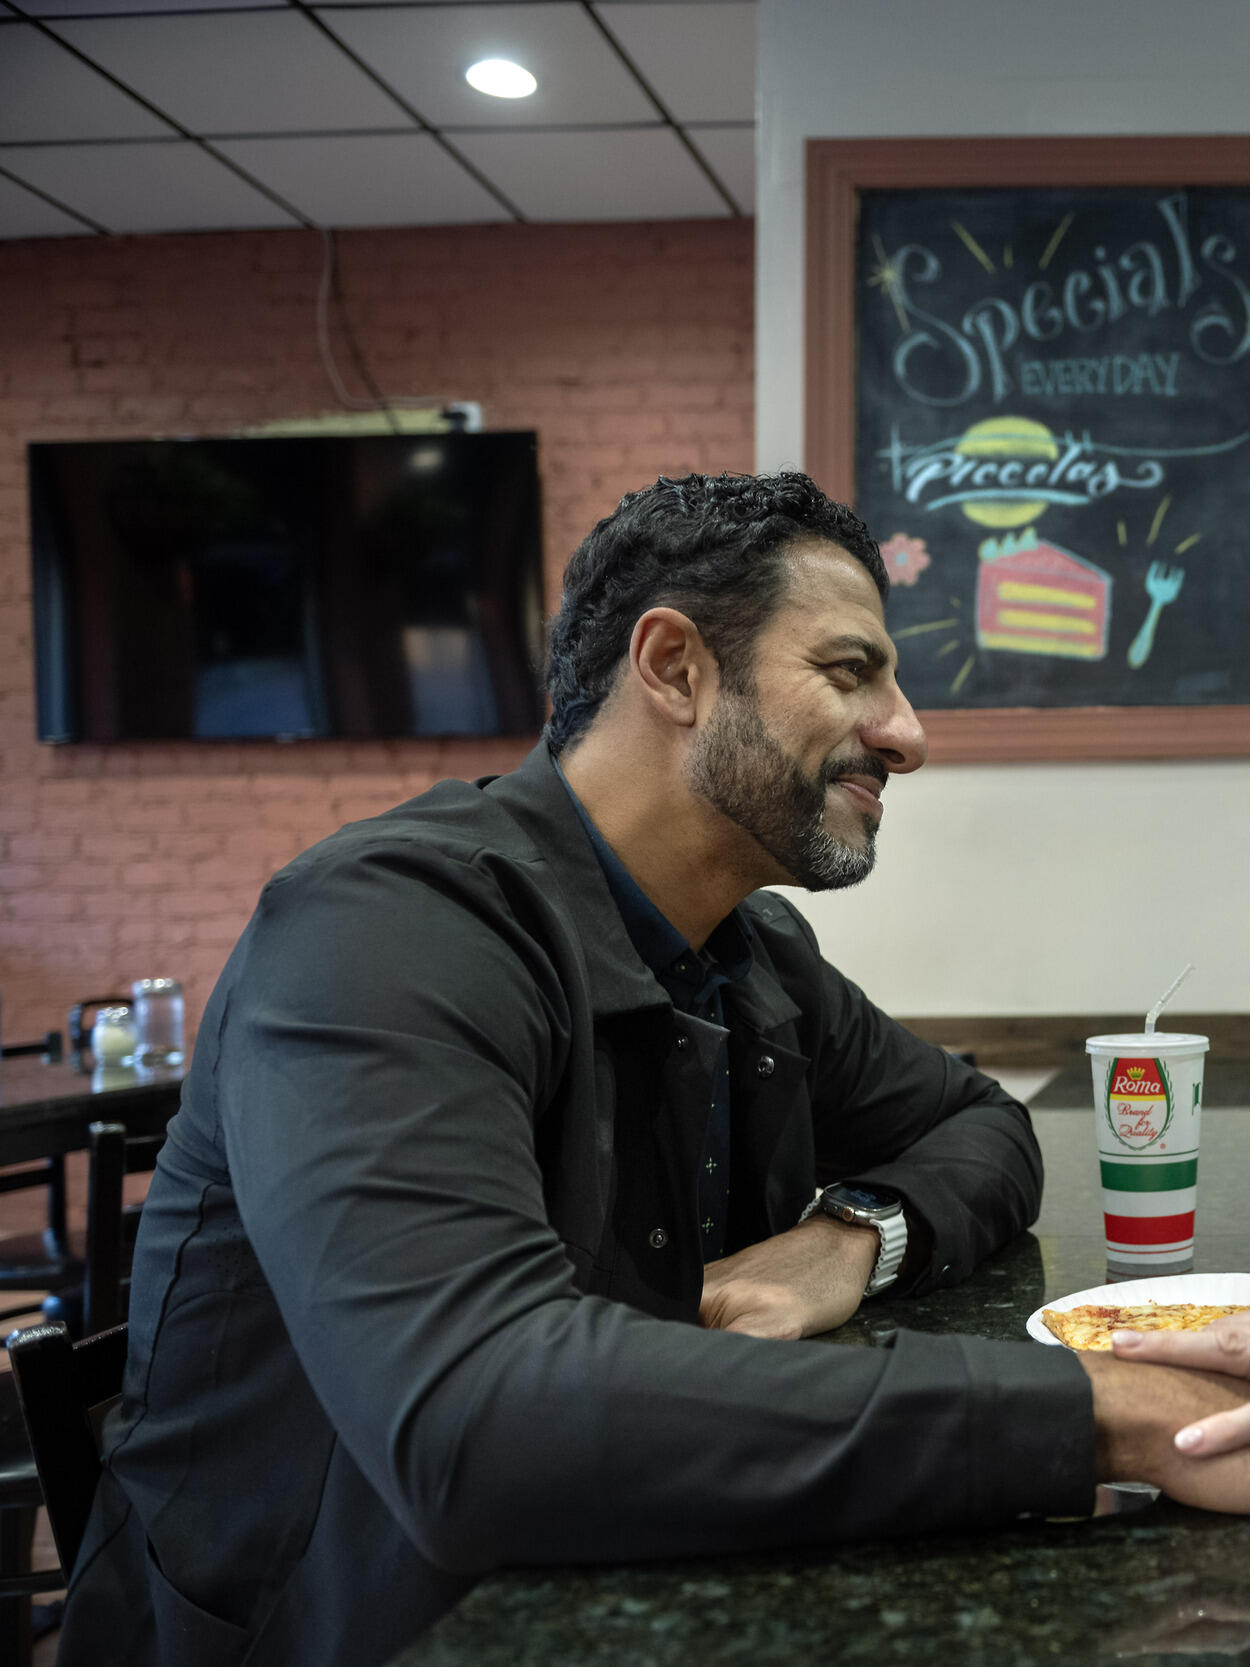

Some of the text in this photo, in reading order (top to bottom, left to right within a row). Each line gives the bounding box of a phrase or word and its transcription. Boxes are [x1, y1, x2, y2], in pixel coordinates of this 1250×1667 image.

[1021, 353, 1181, 397] EVERYDAY
[1113, 1075, 1161, 1094] Roma
[1117, 1102, 1154, 1116] Brand
[1134, 1112, 1151, 1131] for
[1118, 1123, 1158, 1142] Quality
